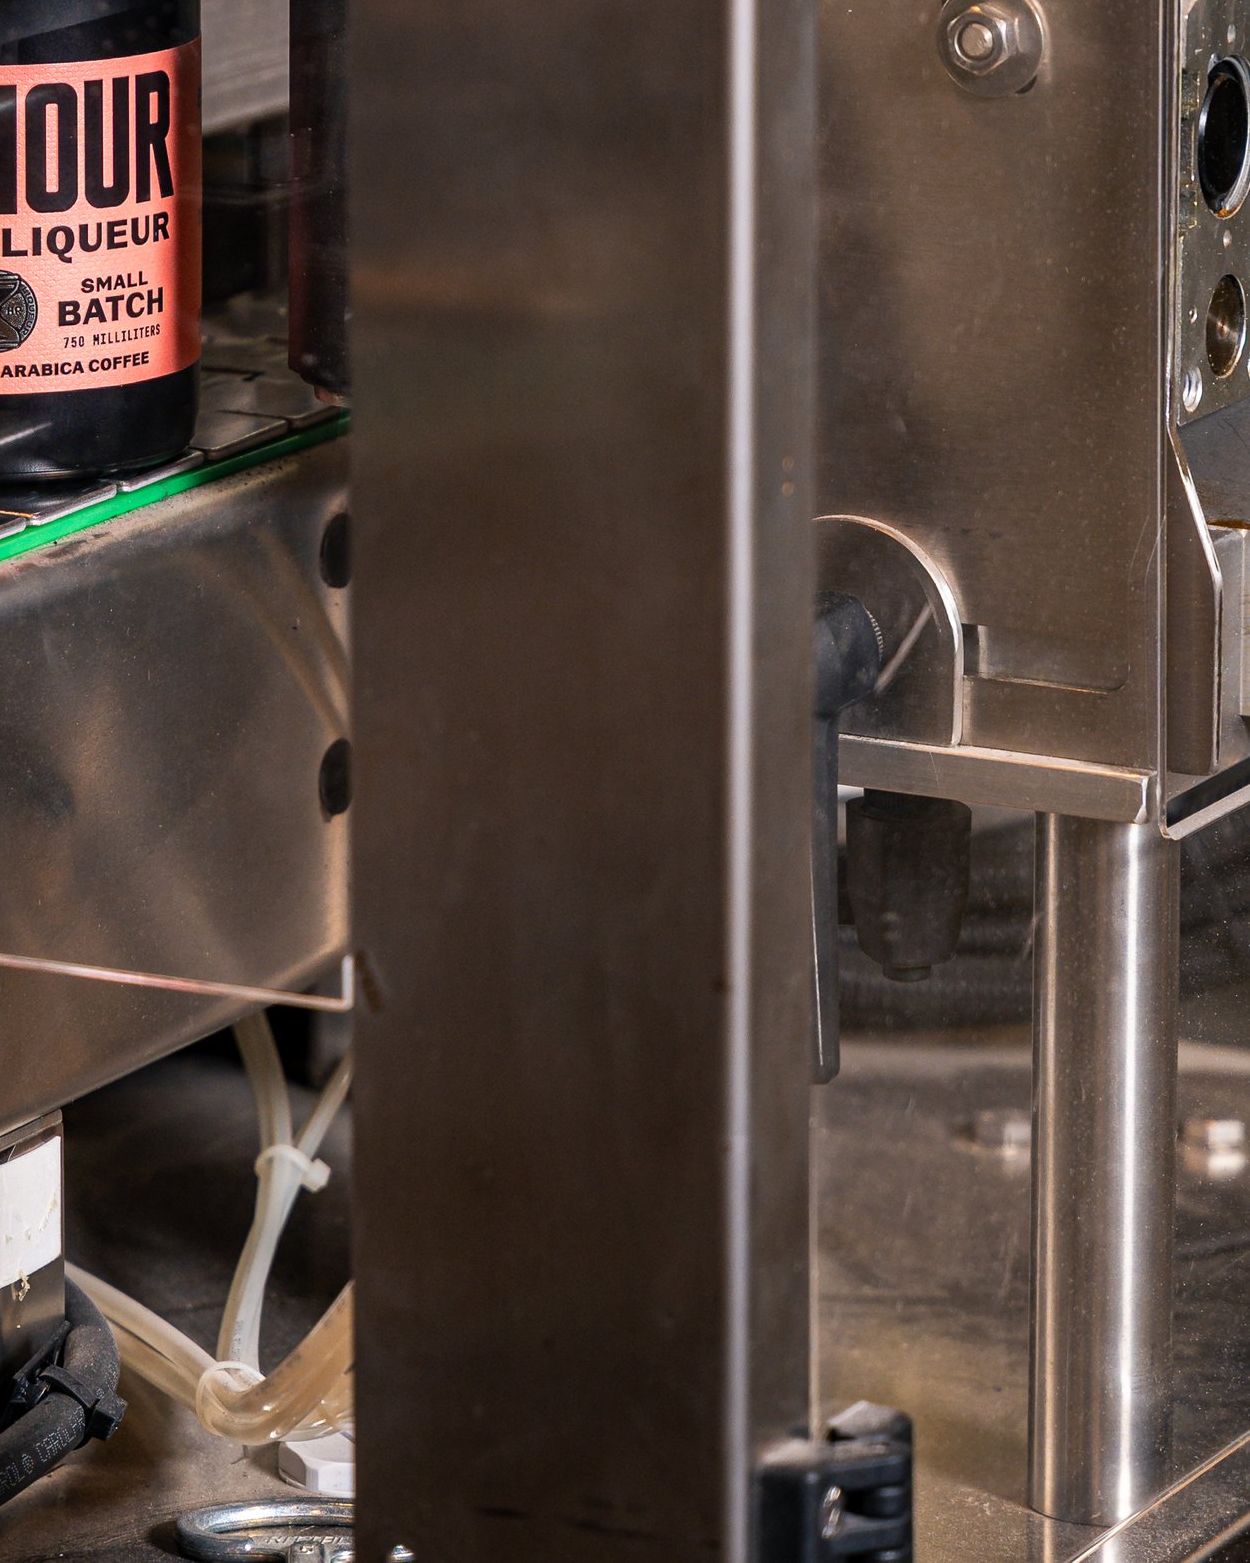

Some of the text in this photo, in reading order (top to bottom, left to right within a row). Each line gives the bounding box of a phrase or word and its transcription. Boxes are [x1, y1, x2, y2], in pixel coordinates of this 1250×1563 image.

[2, 211, 170, 264] LIQUEUR
[80, 270, 148, 294] SMALL
[6, 306, 23, 316] HR
[19, 283, 36, 338] LIQUEUR
[58, 286, 164, 327] BATCH
[63, 323, 161, 349] 750 MILLILITERS
[0, 360, 85, 378] ARABICA
[88, 350, 150, 373] COFFEE
